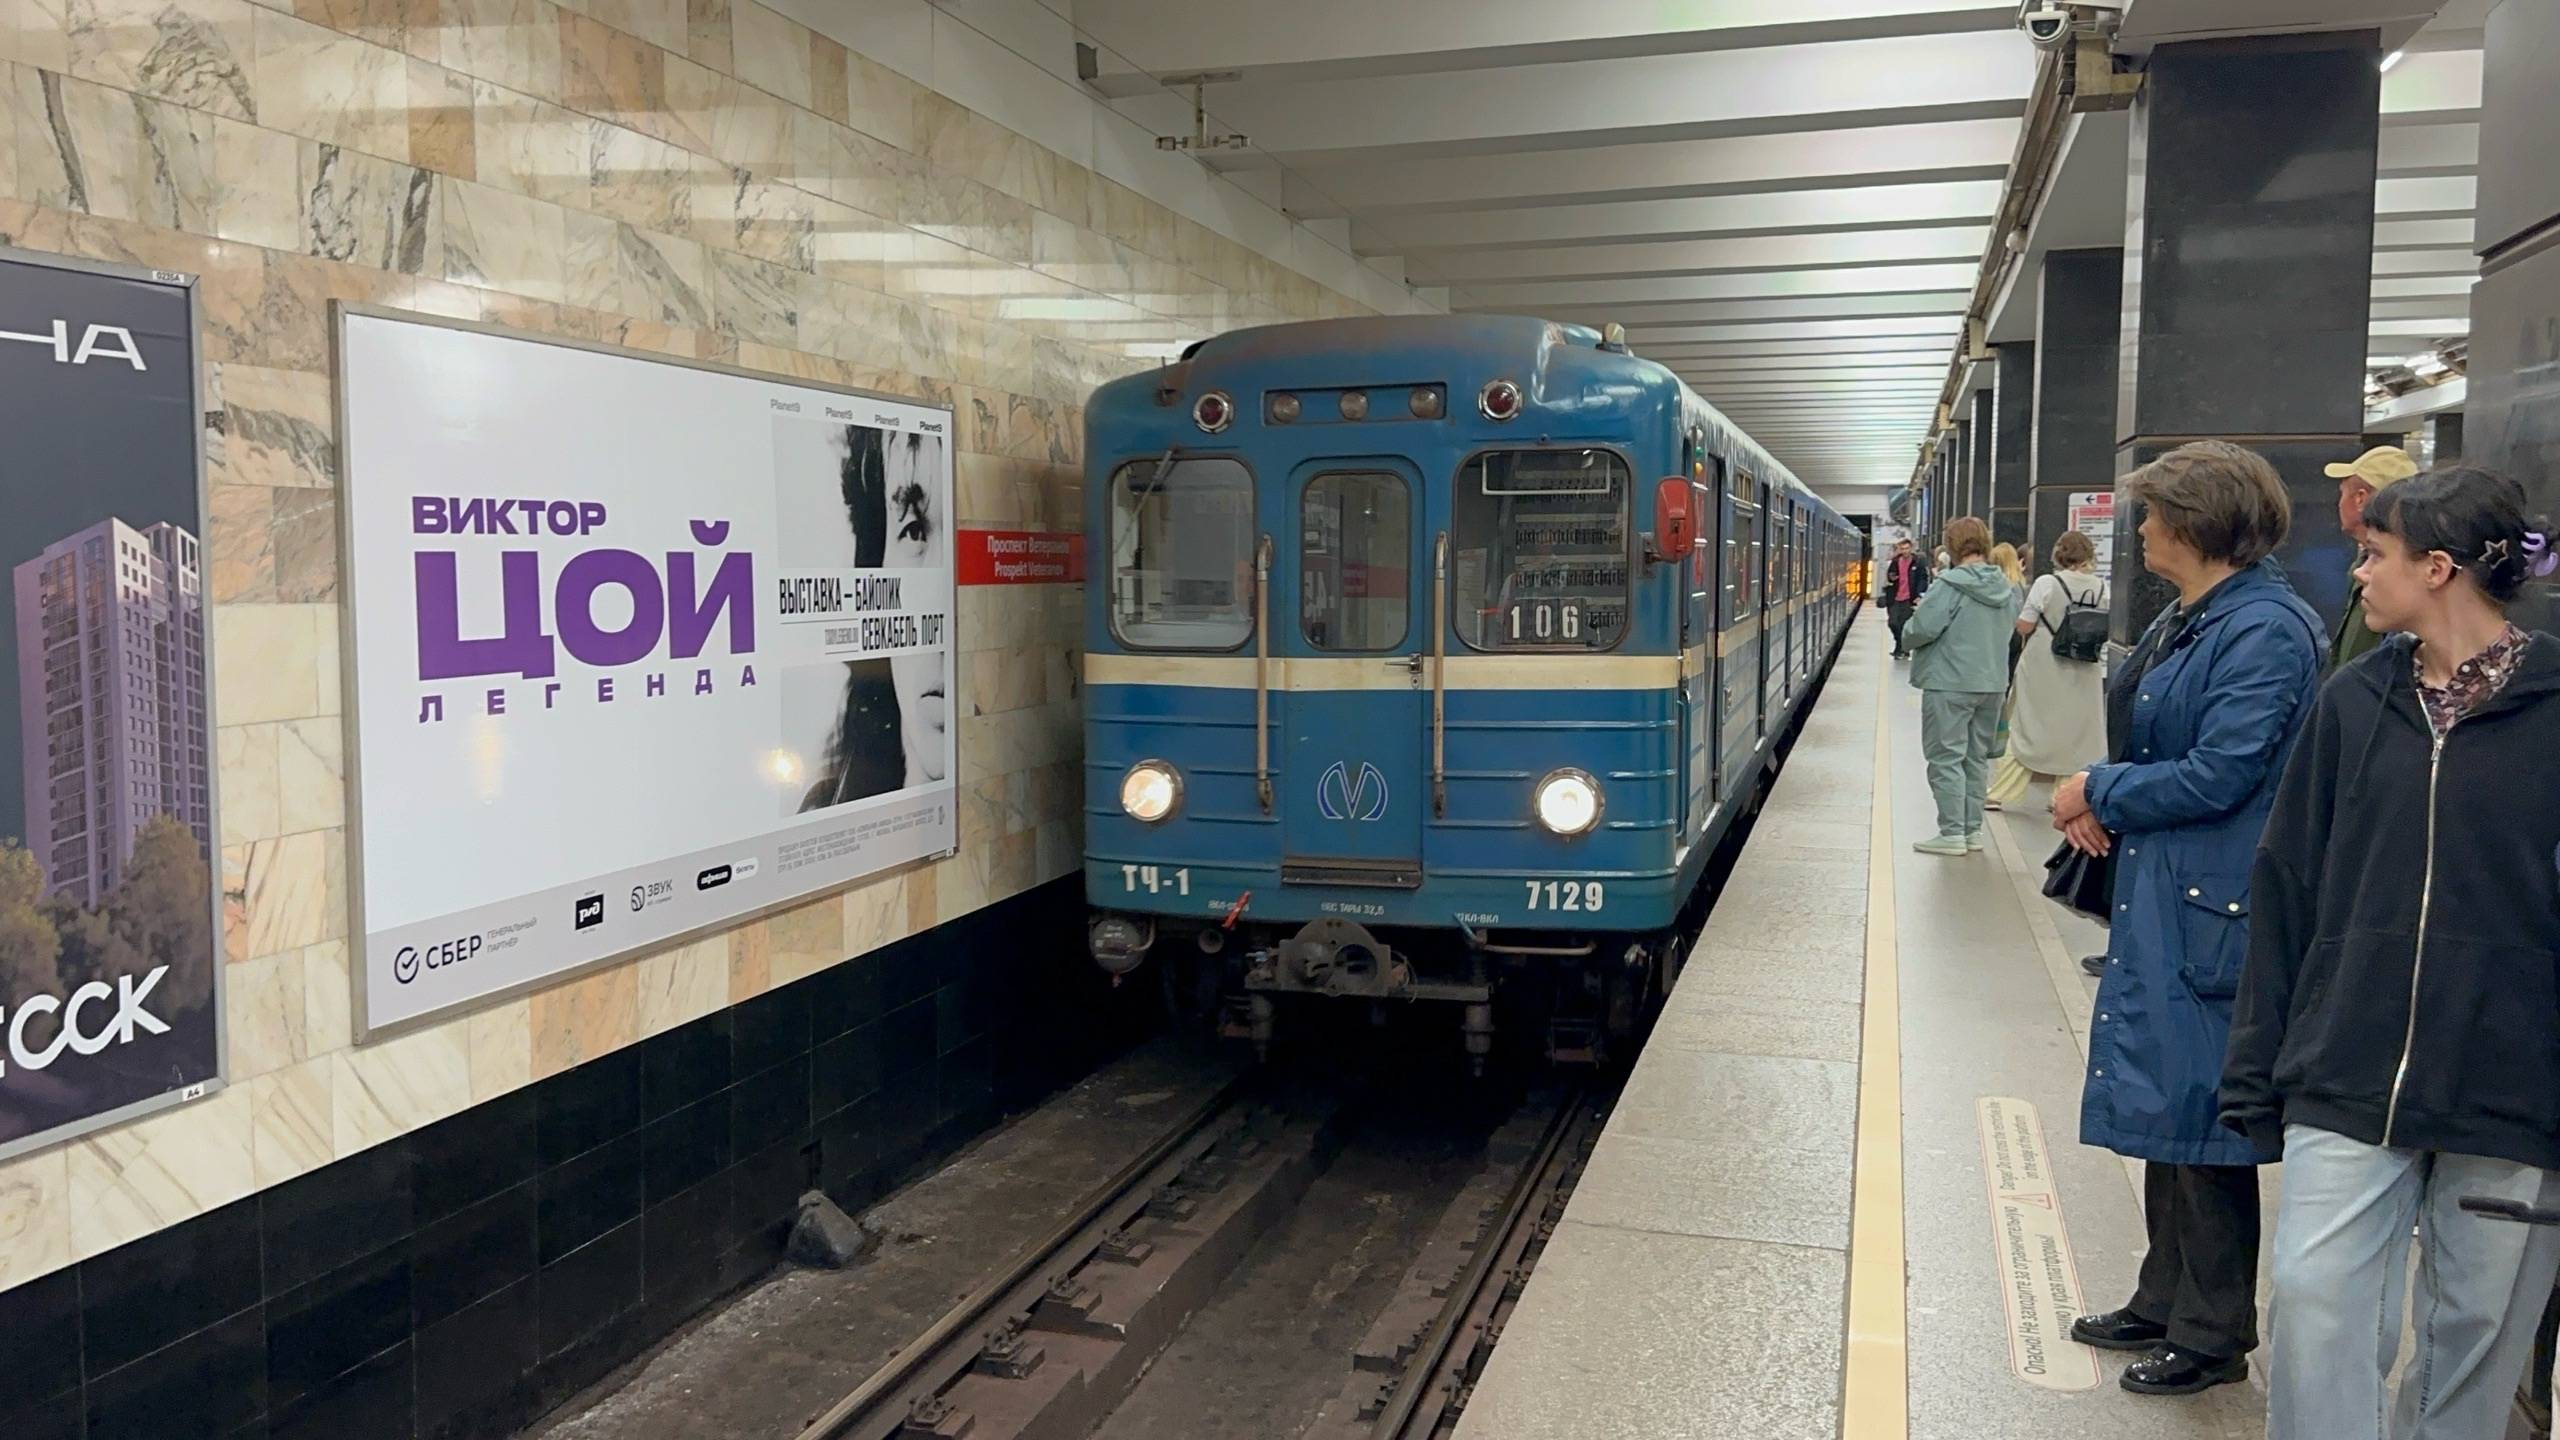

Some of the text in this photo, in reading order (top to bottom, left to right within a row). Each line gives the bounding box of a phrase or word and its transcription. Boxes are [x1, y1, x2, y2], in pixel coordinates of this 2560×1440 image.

[412, 496, 607, 536] ВИКТОР
[987, 535, 1027, 557] Проспект
[994, 560, 1028, 580] Prospekt
[414, 519, 756, 680] ЦОЙ
[779, 577, 842, 614] ВЫСТАВКА
[856, 573, 902, 611] БАЙОПИК
[862, 615, 918, 651] СЕВКАБЕЛЬ
[921, 613, 945, 646] ПОРТ
[419, 665, 756, 723] ЛЕГЕНДА
[648, 879, 673, 898] ЗВУК
[1121, 864, 1190, 896] ТЧ-1
[1525, 880, 1604, 912] 7129
[487, 916, 538, 940] ГЕНЕРАЛЬНЫЙ
[426, 934, 482, 969] СБЕР
[2037, 1233, 2065, 1283] платформы!
[2004, 1206, 2047, 1375] Опасно! Не заходите за ограничительную
[2049, 1282, 2072, 1303] края
